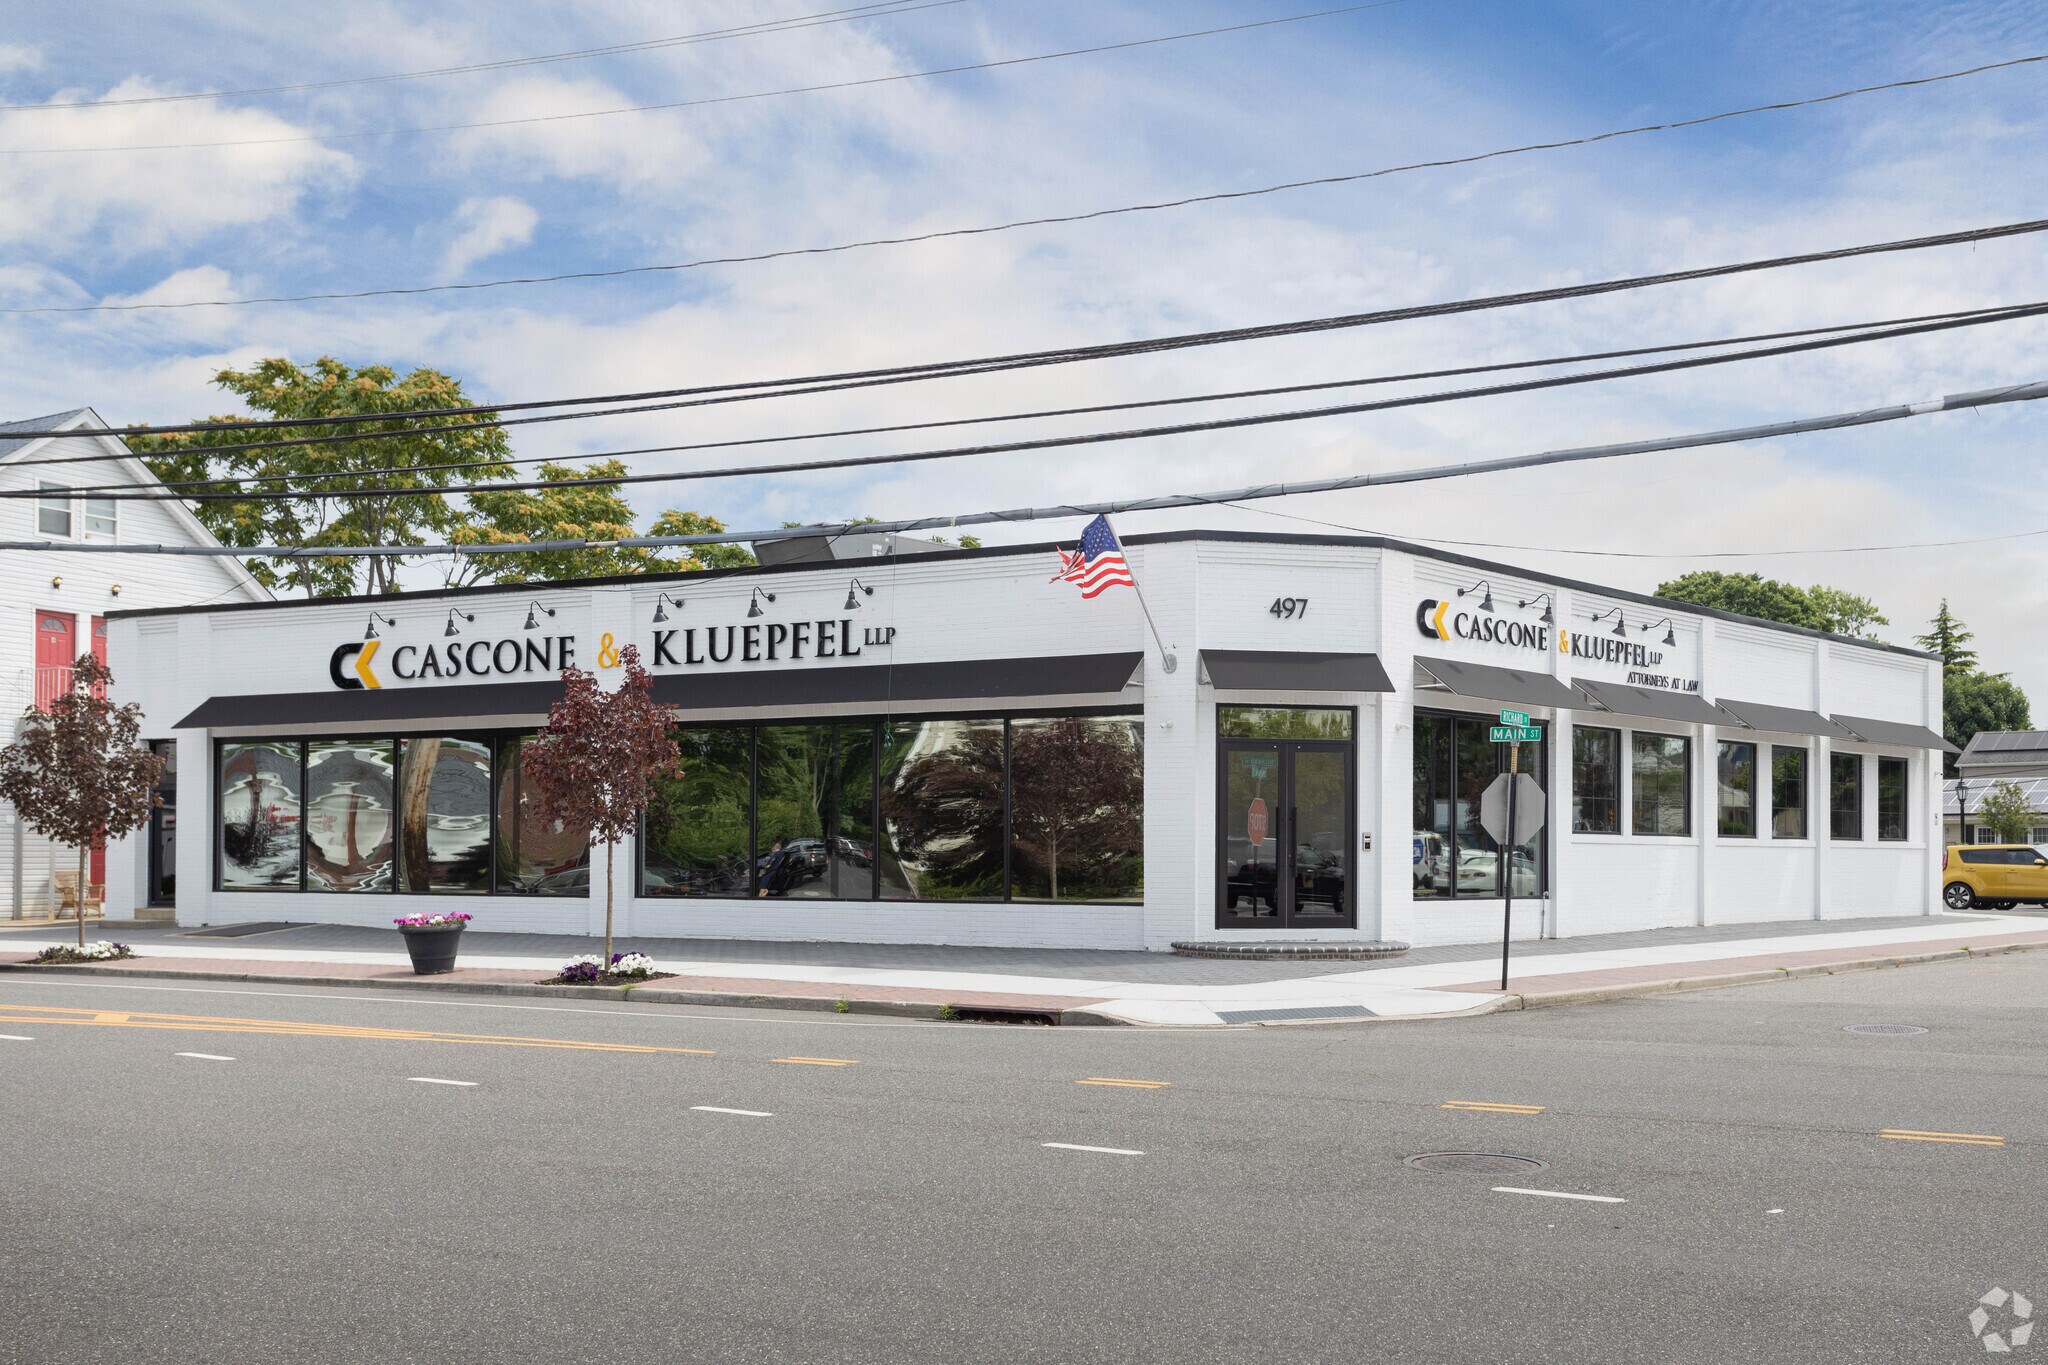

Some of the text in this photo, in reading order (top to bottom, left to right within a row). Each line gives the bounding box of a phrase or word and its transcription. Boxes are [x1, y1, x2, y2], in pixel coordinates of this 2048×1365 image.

[1269, 597, 1309, 619] 497
[391, 619, 896, 679] CASCONE & KLUEPFEL LLP
[1454, 612, 1663, 668] CASCONE & KLUEPFEL LLP
[1627, 671, 1699, 692] ATTORNEYS AT LAW
[1503, 711, 1523, 724] RICHARD
[1493, 728, 1539, 740] MAIN ST
